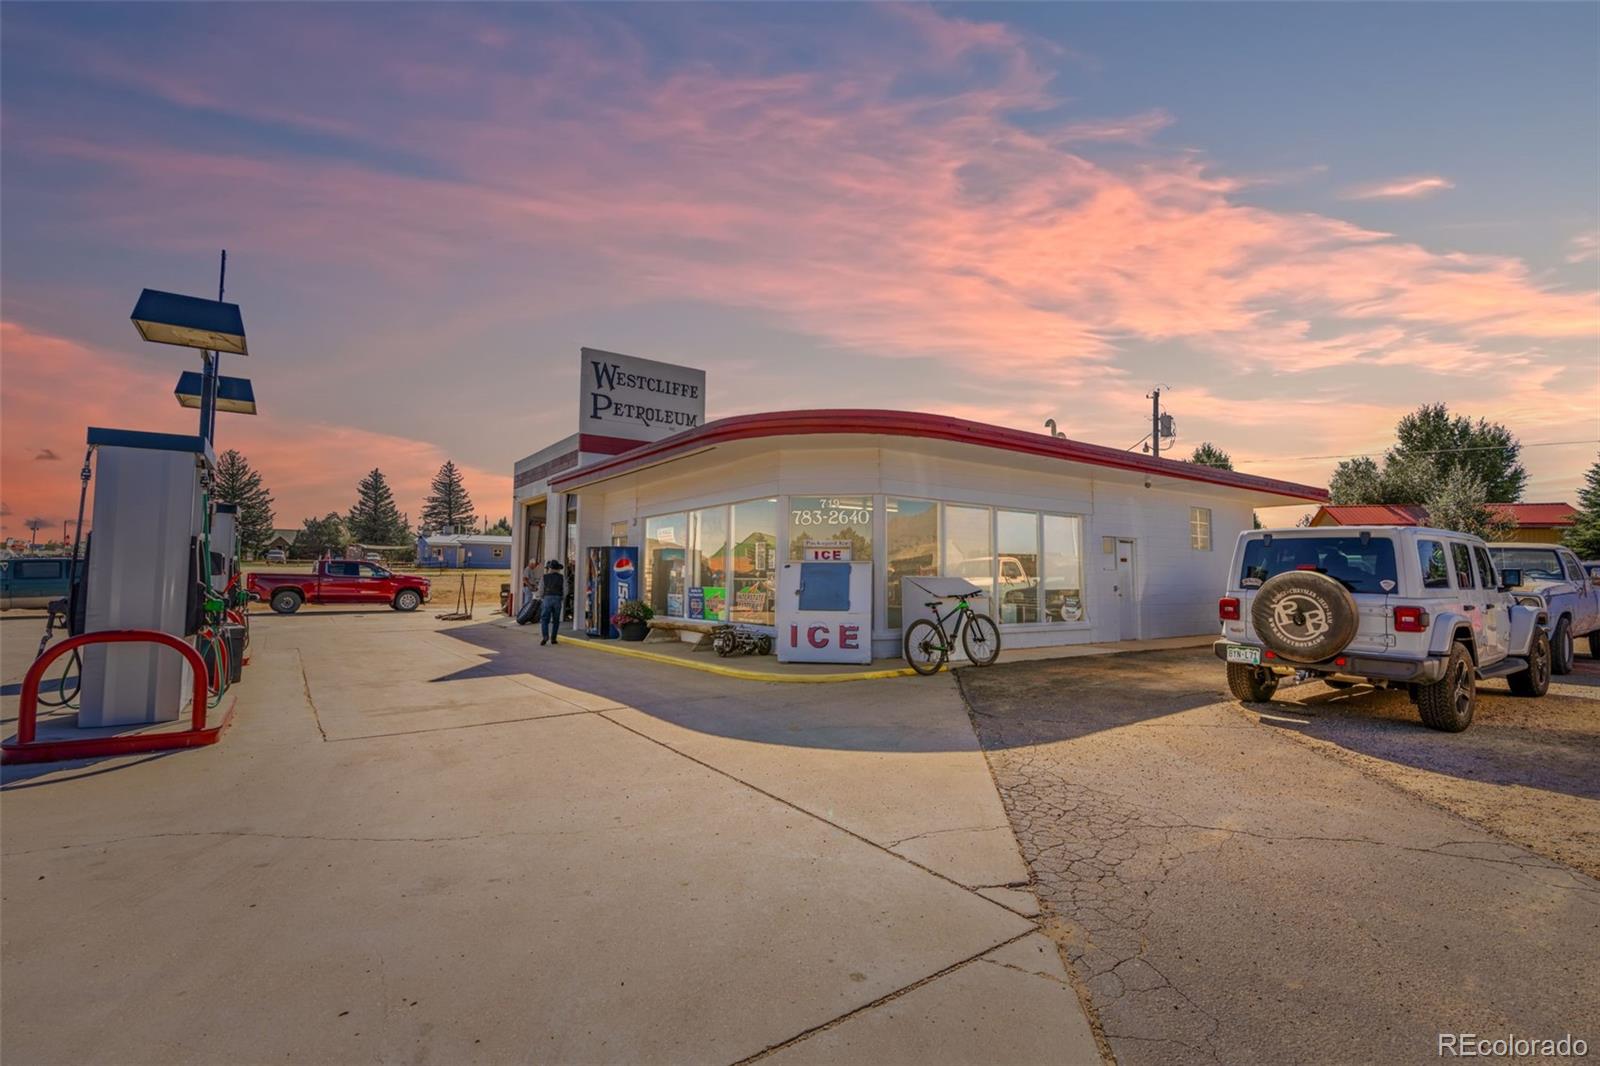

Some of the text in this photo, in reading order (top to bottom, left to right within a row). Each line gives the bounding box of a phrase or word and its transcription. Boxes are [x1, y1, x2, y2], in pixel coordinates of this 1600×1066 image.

[591, 360, 699, 399] WESTCLIFFE
[590, 392, 698, 427] PETROLEUM
[792, 510, 870, 525] 783-2640
[814, 550, 842, 561] ICE
[790, 622, 860, 649] ICE
